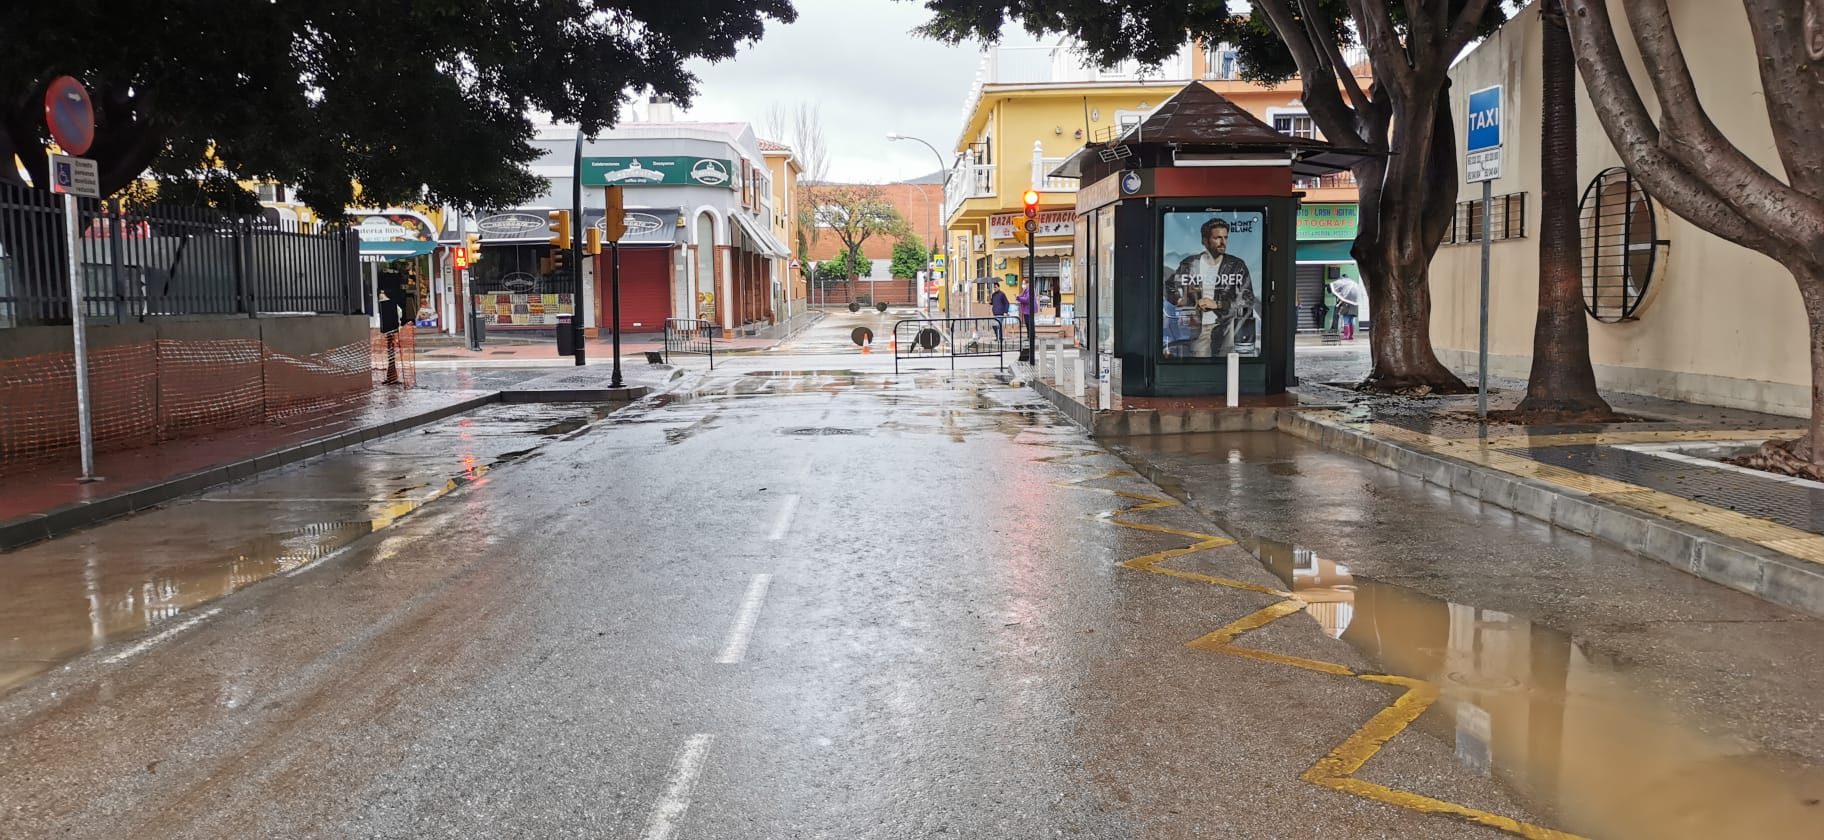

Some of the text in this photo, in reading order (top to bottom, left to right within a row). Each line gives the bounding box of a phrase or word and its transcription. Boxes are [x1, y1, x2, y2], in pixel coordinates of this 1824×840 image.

[1469, 107, 1499, 131] TAXI
[1310, 207, 1331, 217] FLASH
[991, 214, 1014, 227] BAZA
